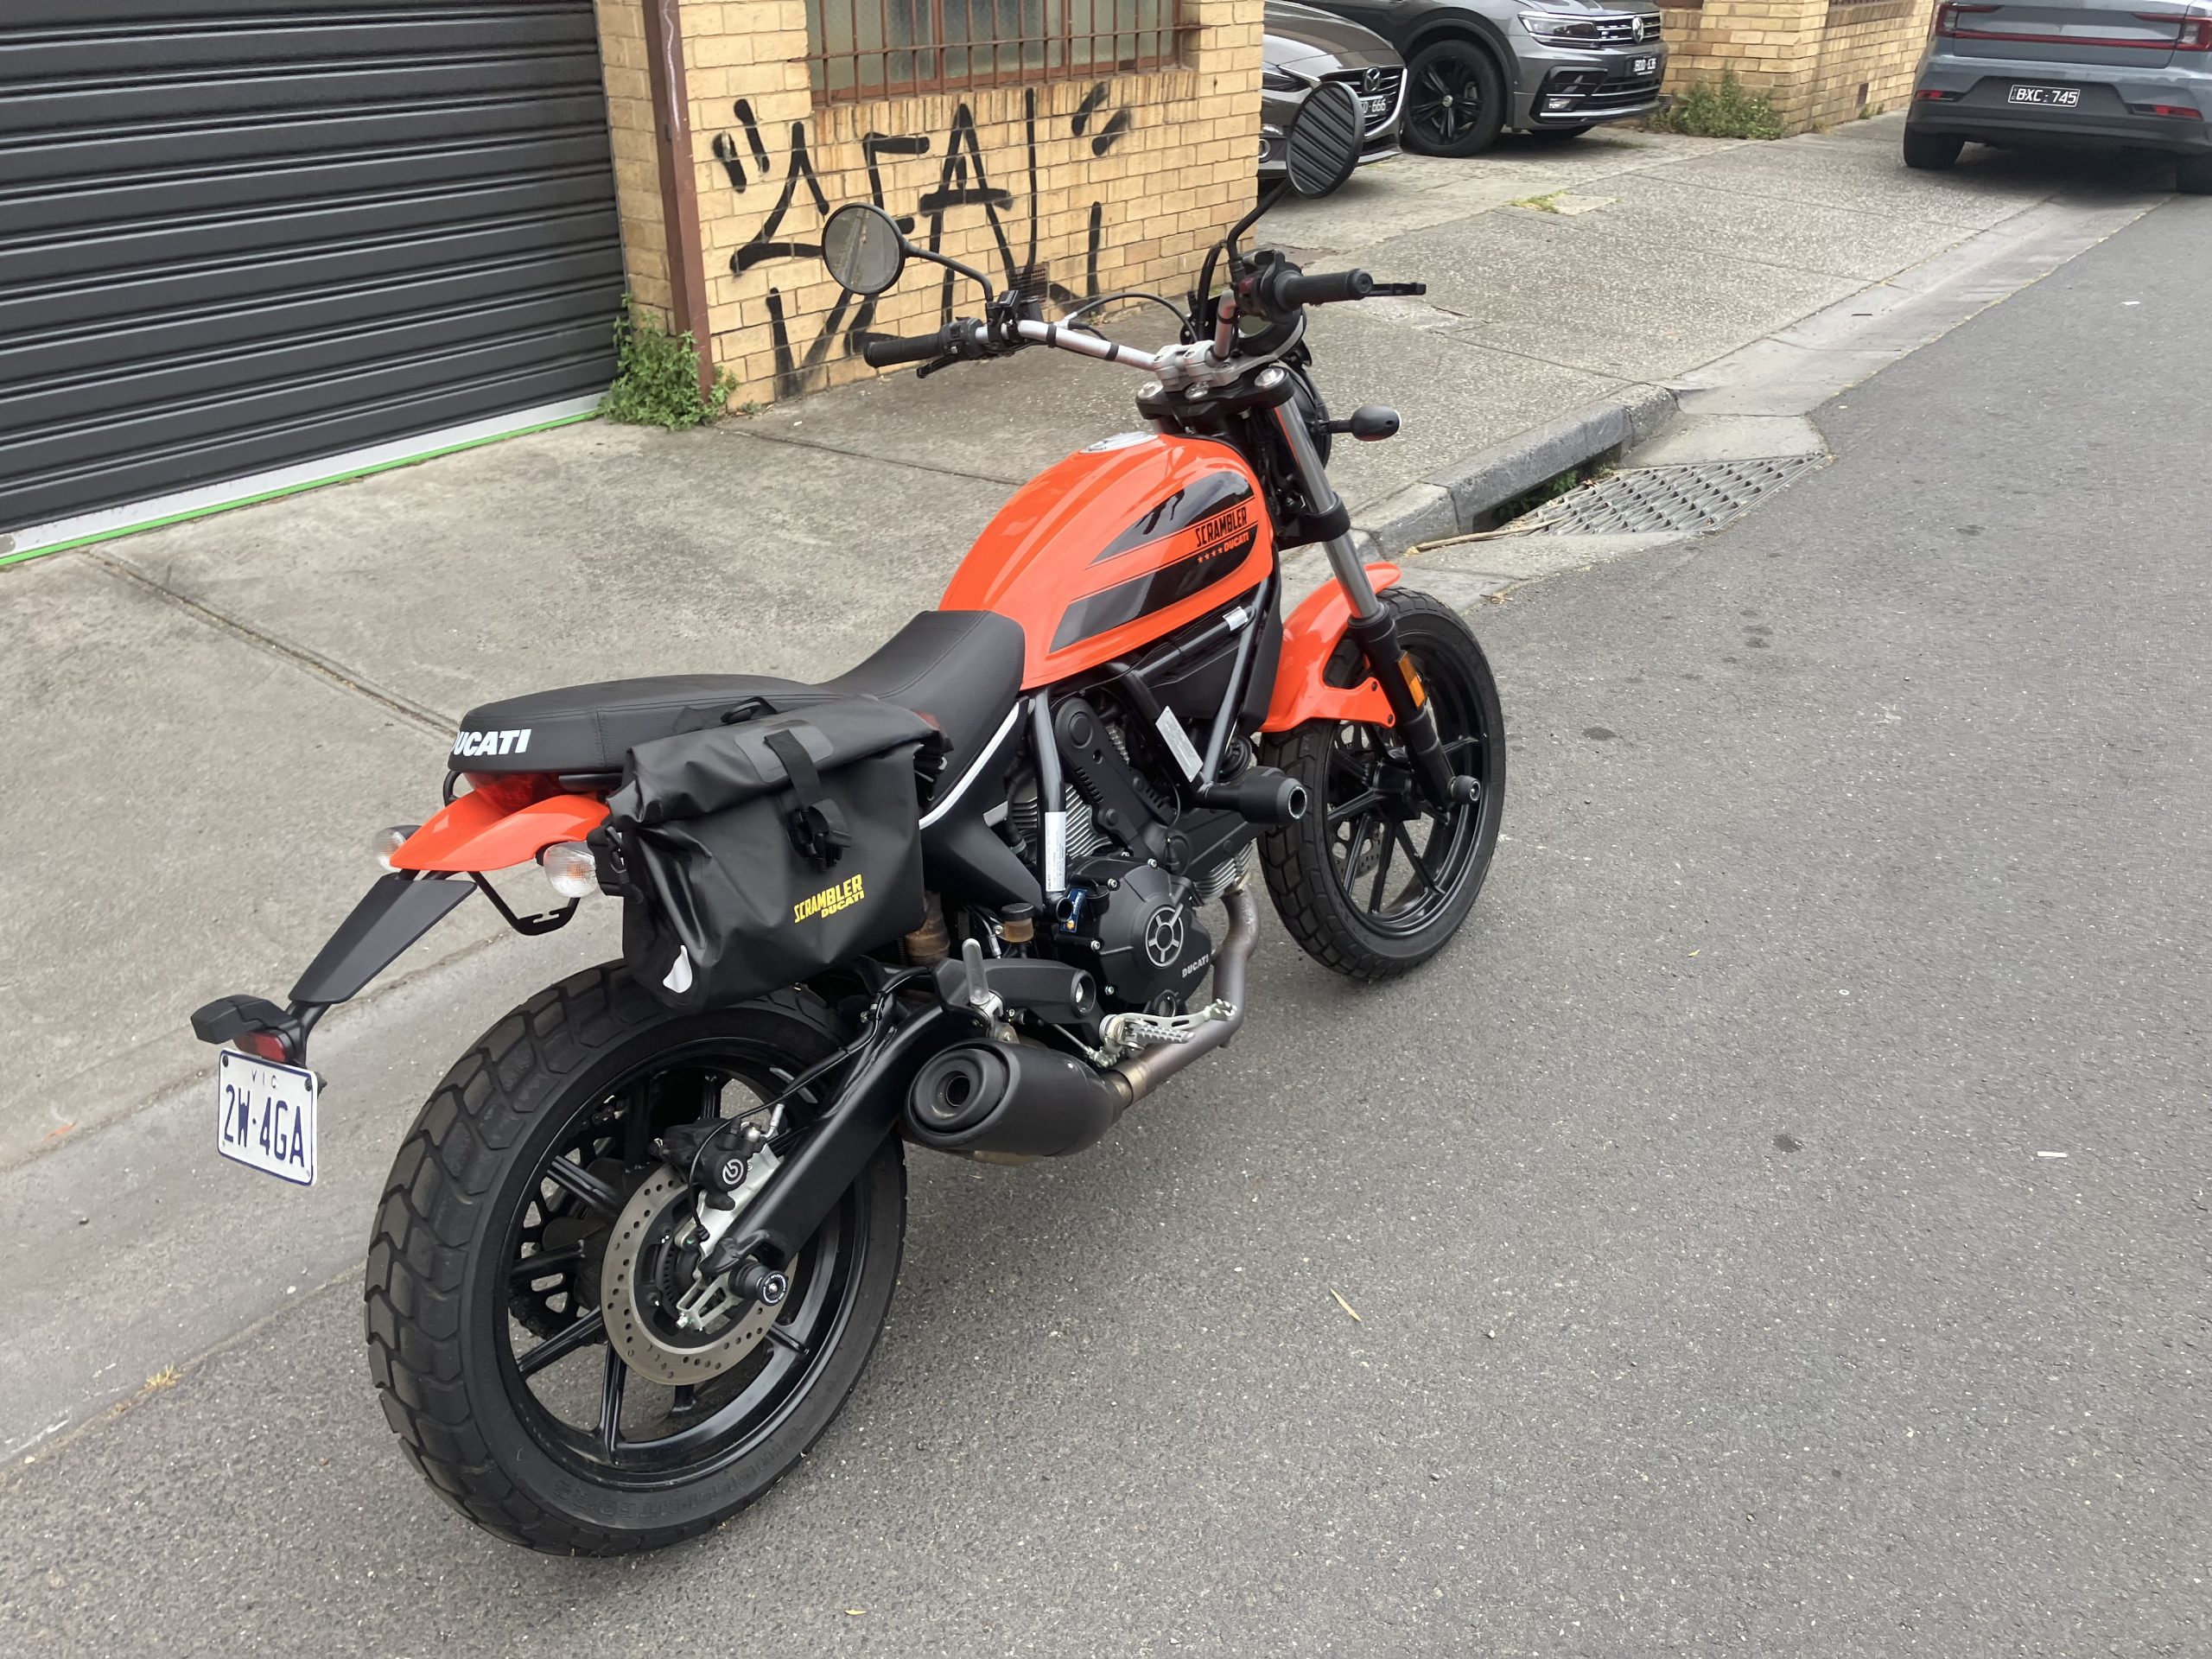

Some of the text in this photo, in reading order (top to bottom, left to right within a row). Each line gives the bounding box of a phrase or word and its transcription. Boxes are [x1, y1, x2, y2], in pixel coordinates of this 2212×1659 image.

[1195, 505, 1247, 547] SCRAMBLER
[1224, 531, 1249, 551] DUCATI
[451, 728, 531, 757] UCATI
[793, 874, 863, 924] SCRAMBLER
[821, 890, 865, 918] DUCATI
[1181, 953, 1209, 978] DUCATI
[251, 1070, 277, 1089] VIC
